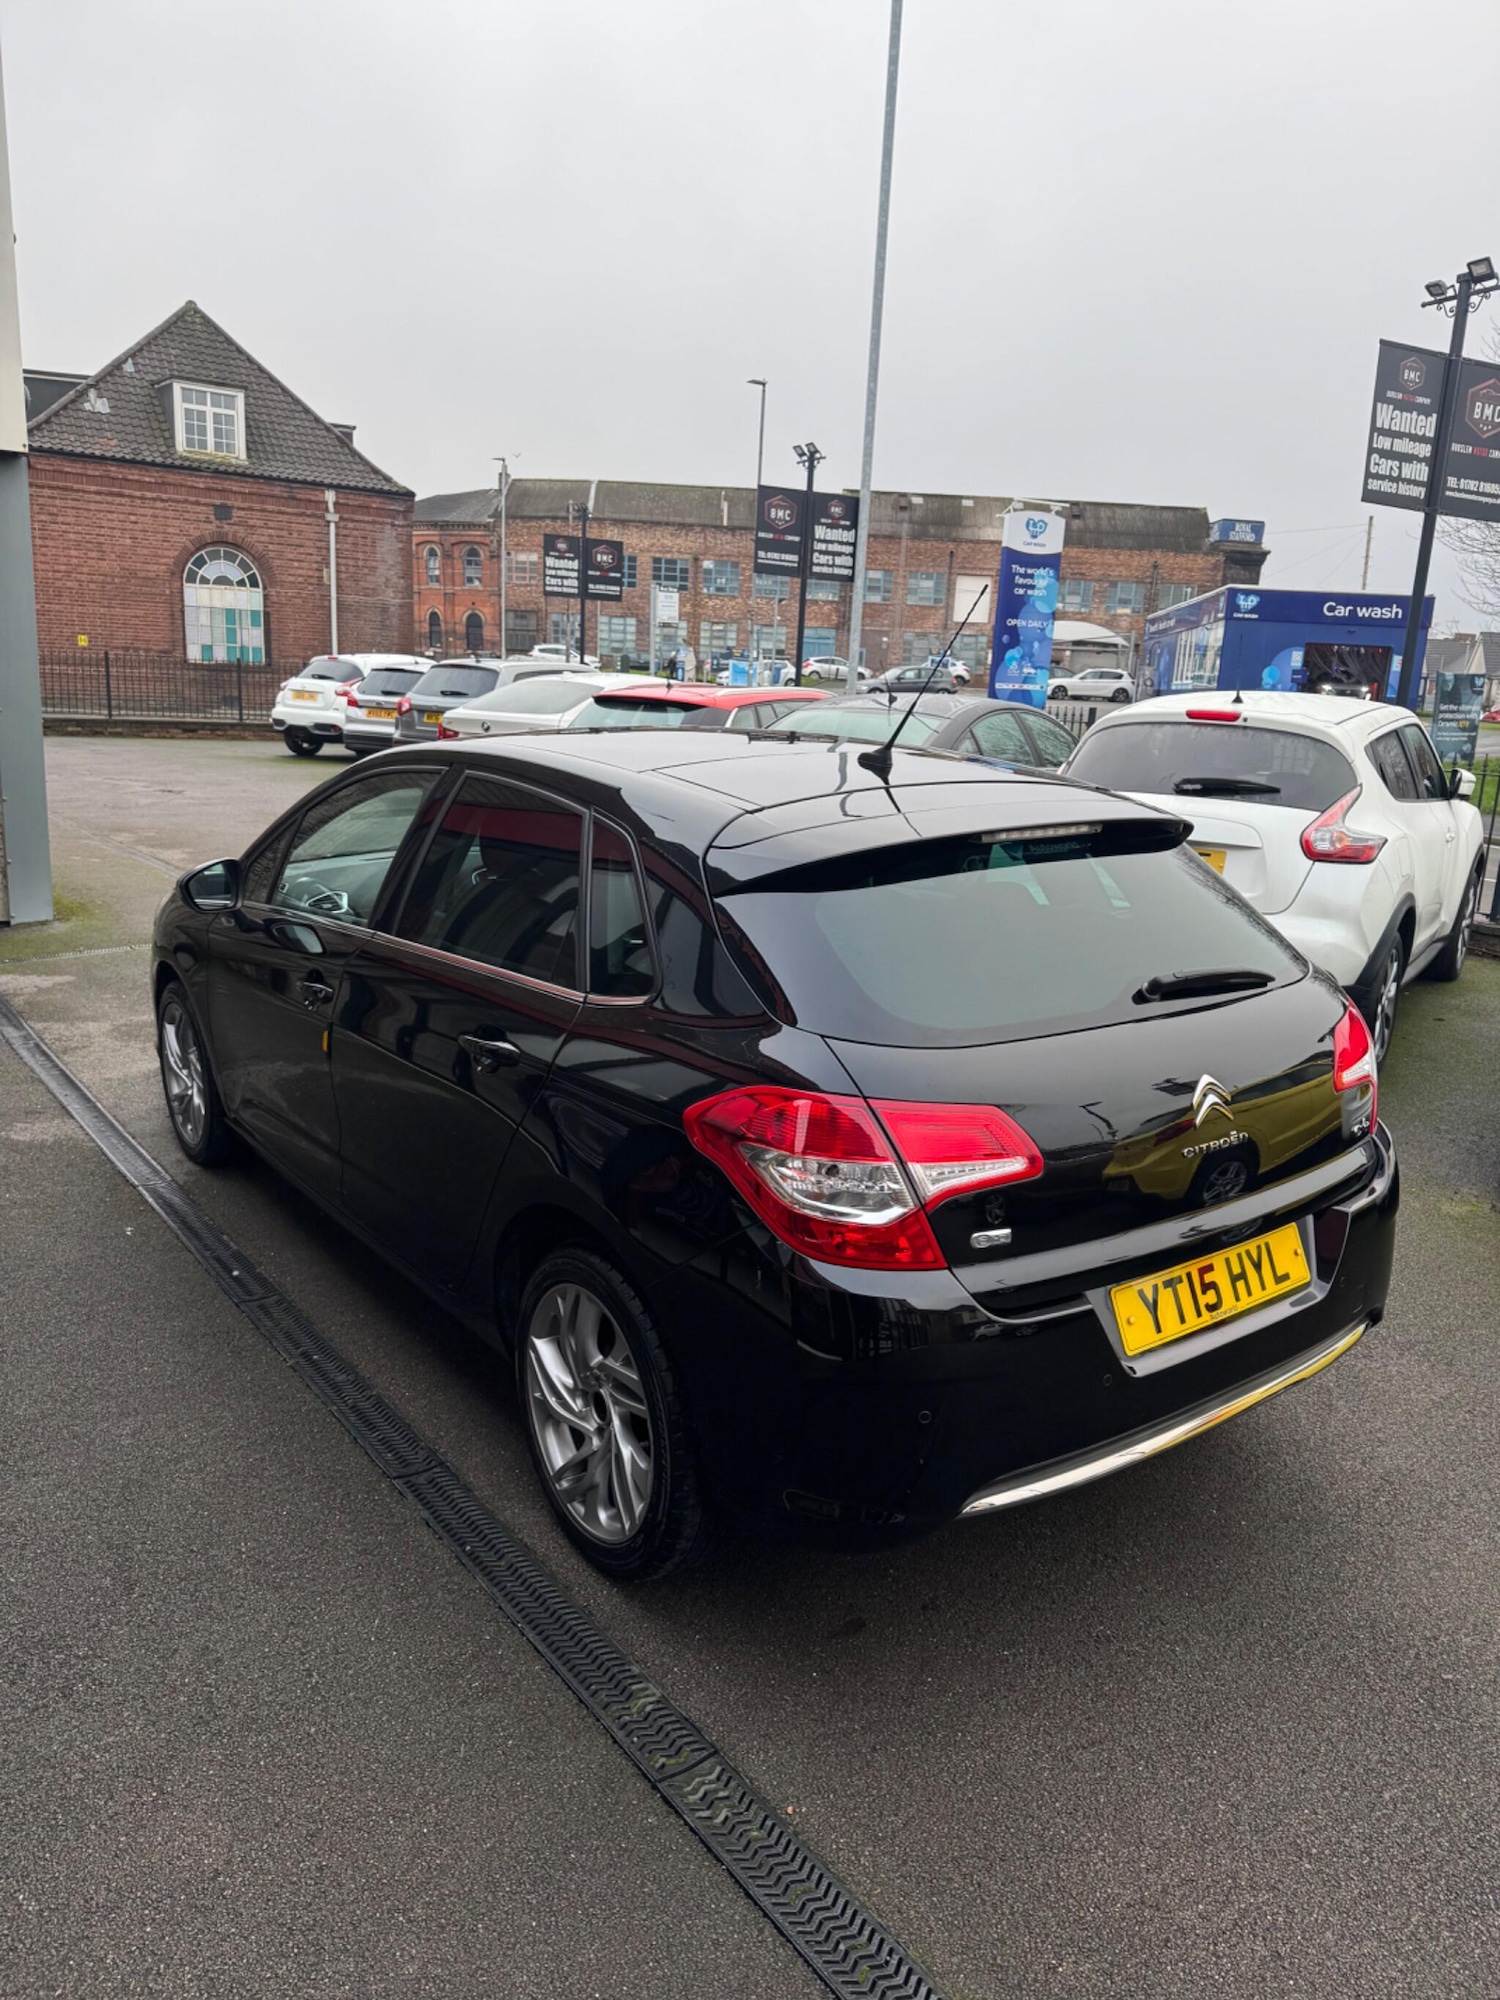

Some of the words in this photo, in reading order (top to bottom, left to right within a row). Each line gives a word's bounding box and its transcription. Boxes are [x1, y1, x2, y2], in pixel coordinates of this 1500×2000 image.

[1404, 369, 1421, 382] BMC
[1376, 401, 1437, 437] Wanted
[1373, 432, 1392, 450] Low
[1393, 437, 1432, 457] mileage
[1370, 453, 1399, 477] Cars
[1401, 460, 1429, 482] with
[1367, 478, 1397, 493] service
[1397, 481, 1426, 499] history
[770, 508, 791, 520] BMC
[814, 525, 855, 543] Wanted
[545, 556, 579, 570] Wanted
[812, 552, 834, 565] Cars
[1012, 565, 1025, 574] The
[1323, 601, 1354, 617] Car
[1356, 603, 1403, 619] wash
[1006, 618, 1027, 627] OPEN
[1027, 619, 1048, 629] DAILY
[1181, 1130, 1249, 1159] CITROËN
[1136, 1262, 1223, 1335] YT15
[1225, 1241, 1291, 1303] HYL
